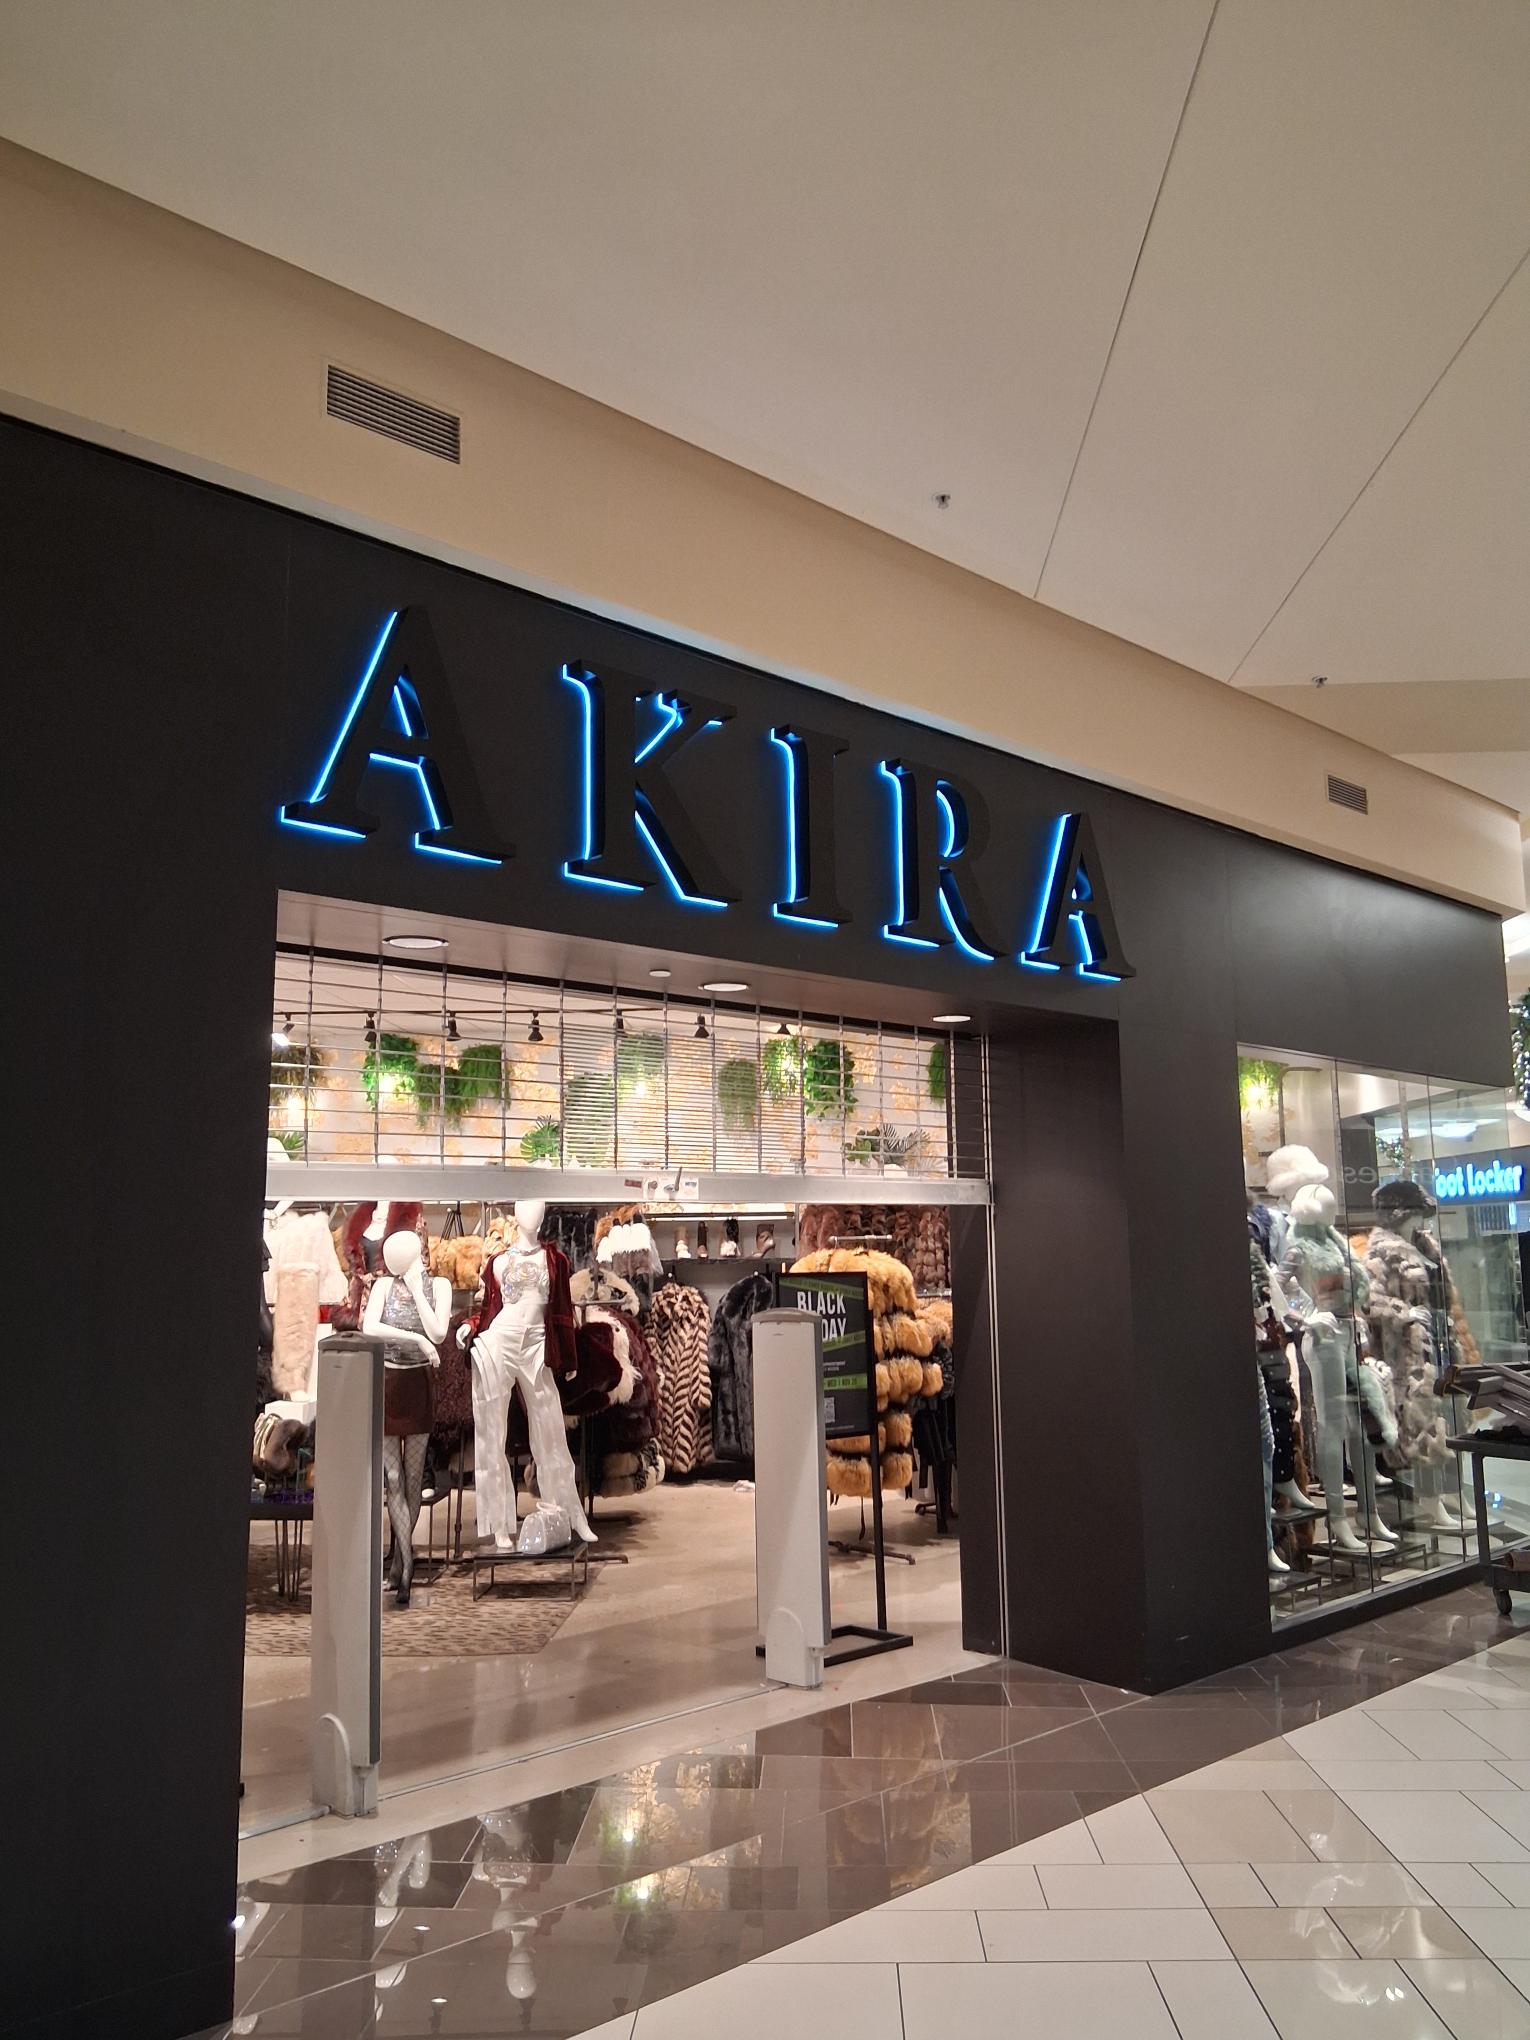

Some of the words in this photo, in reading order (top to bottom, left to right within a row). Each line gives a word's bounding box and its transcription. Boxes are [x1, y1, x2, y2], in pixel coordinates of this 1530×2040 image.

[278, 605, 1138, 983] AKIRA
[1434, 1167, 1465, 1198] oot
[1467, 1160, 1522, 1196] Locker
[797, 1291, 846, 1316] BLACK
[821, 1317, 847, 1342] DAY
